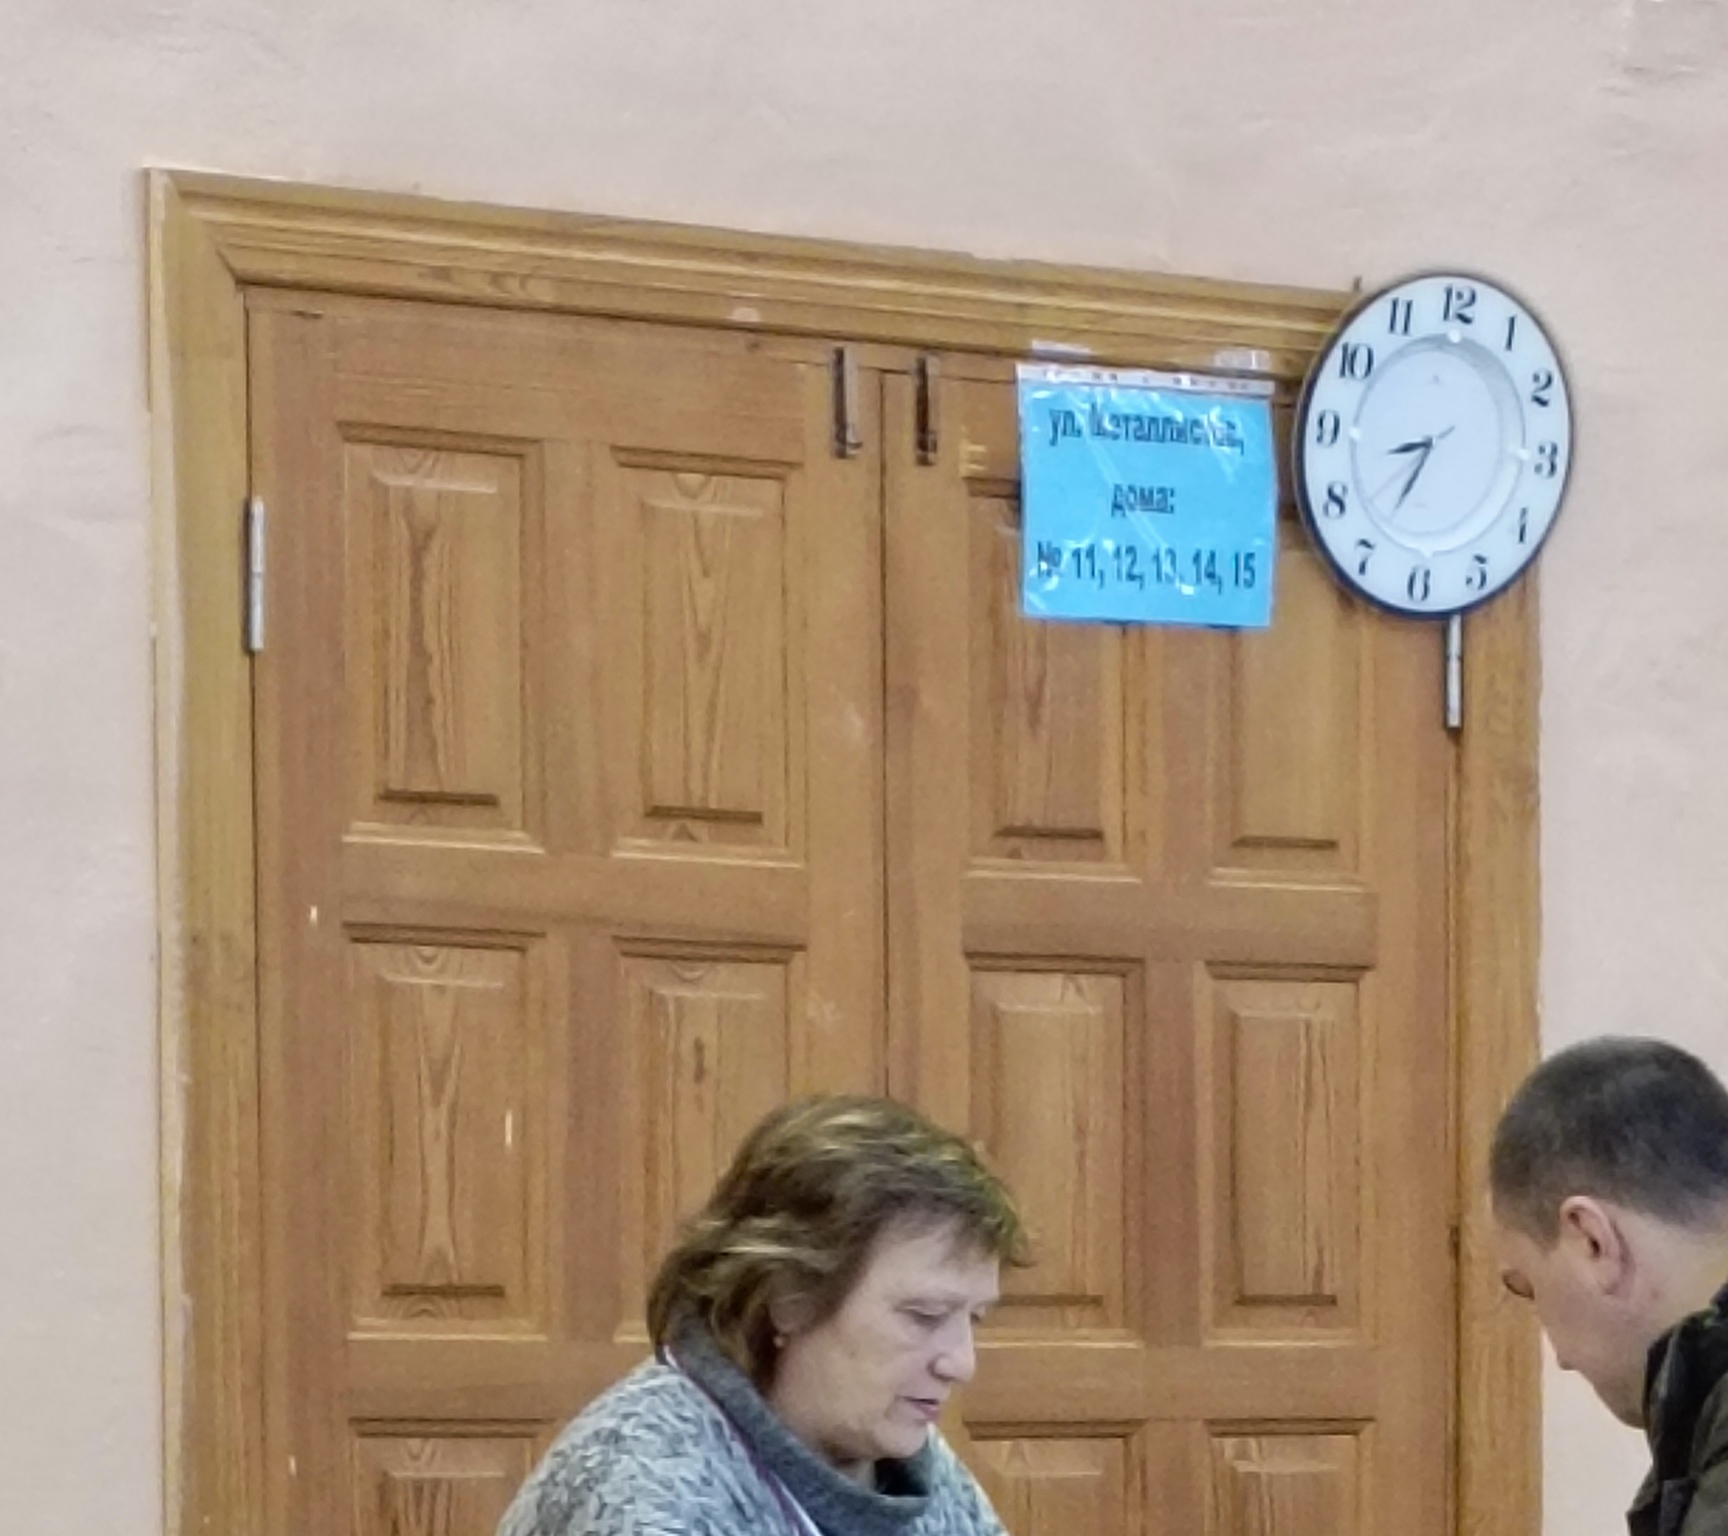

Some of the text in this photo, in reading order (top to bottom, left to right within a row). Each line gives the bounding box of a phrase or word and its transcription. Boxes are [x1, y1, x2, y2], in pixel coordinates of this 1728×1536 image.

[1389, 297, 1413, 336] 11
[1443, 284, 1477, 324] 12
[1504, 315, 1517, 351] 1
[1339, 342, 1374, 380] 10
[1531, 368, 1553, 407] 2
[1050, 409, 1082, 446] ул.
[1316, 410, 1341, 446] 9
[1534, 442, 1558, 479] 3
[1111, 483, 1175, 518] дома:
[1323, 481, 1347, 519] 8
[1071, 543, 1105, 590] 11,
[1112, 545, 1145, 590] 12,
[1193, 549, 1223, 594] 14,
[1233, 550, 1256, 589] 15
[1357, 539, 1375, 575] 7
[1465, 554, 1488, 591] 5
[1406, 566, 1431, 601] 6
